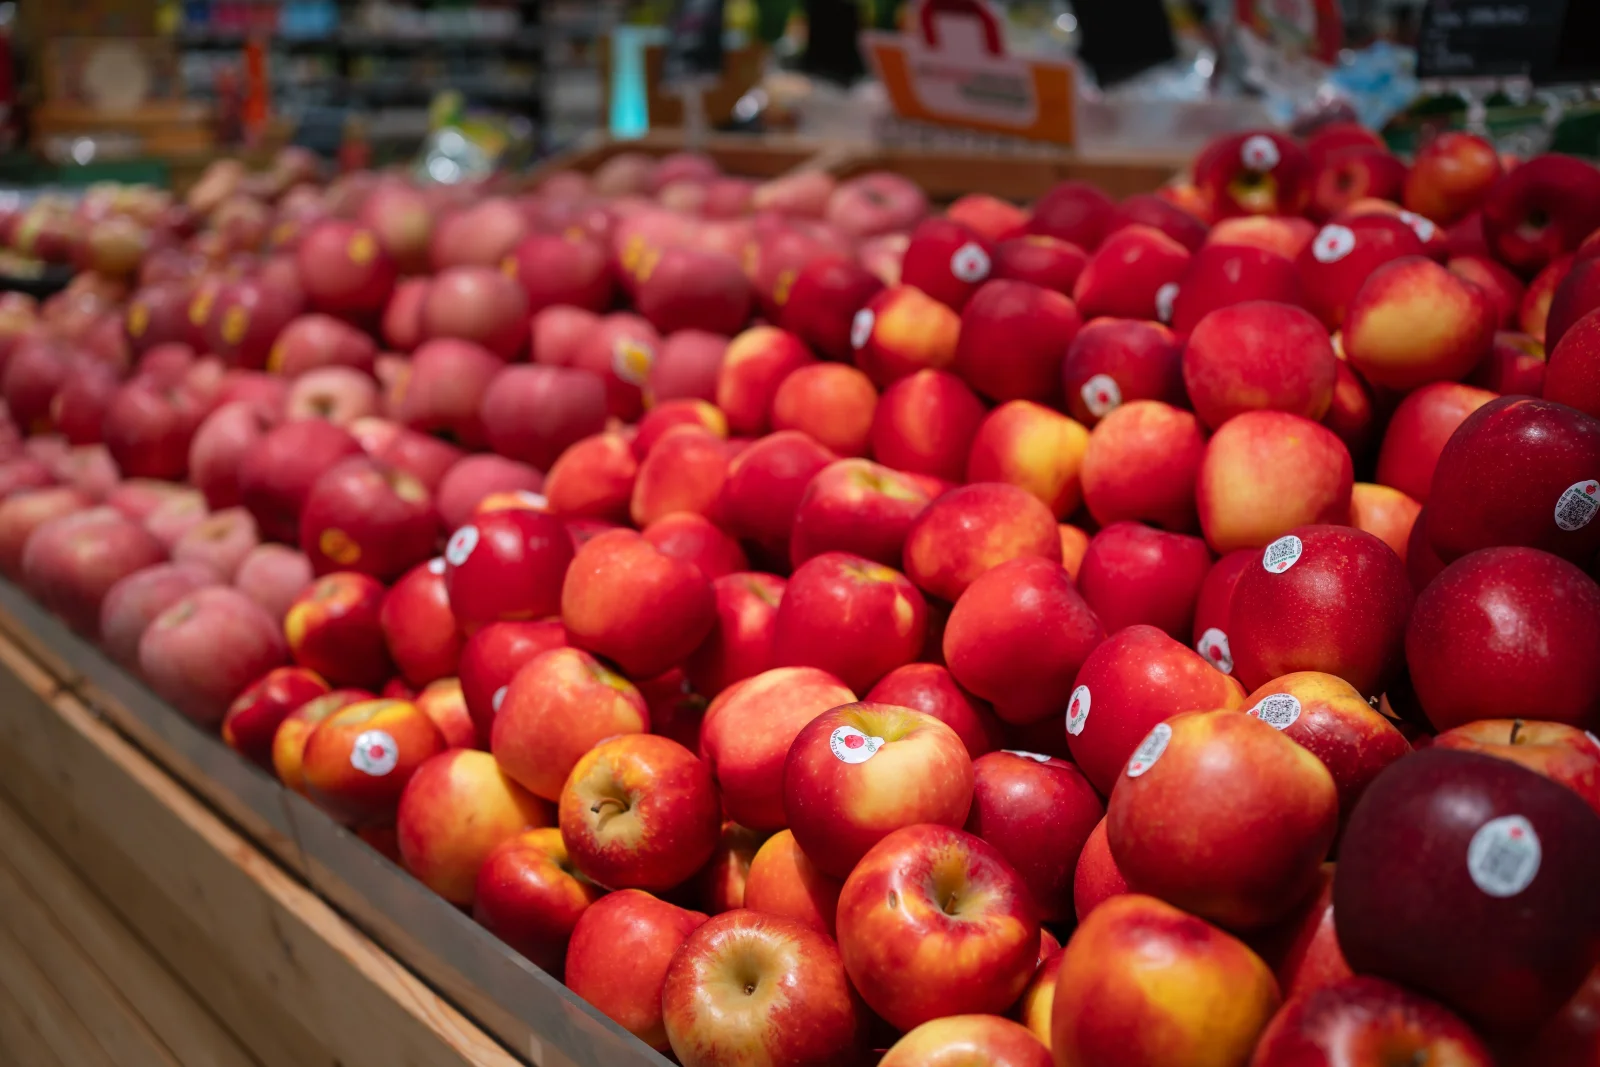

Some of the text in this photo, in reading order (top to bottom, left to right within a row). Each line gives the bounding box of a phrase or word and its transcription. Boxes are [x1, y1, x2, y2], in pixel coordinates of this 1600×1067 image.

[1580, 492, 1598, 506] APPLE
[831, 729, 846, 761] NEW ZEALAND
